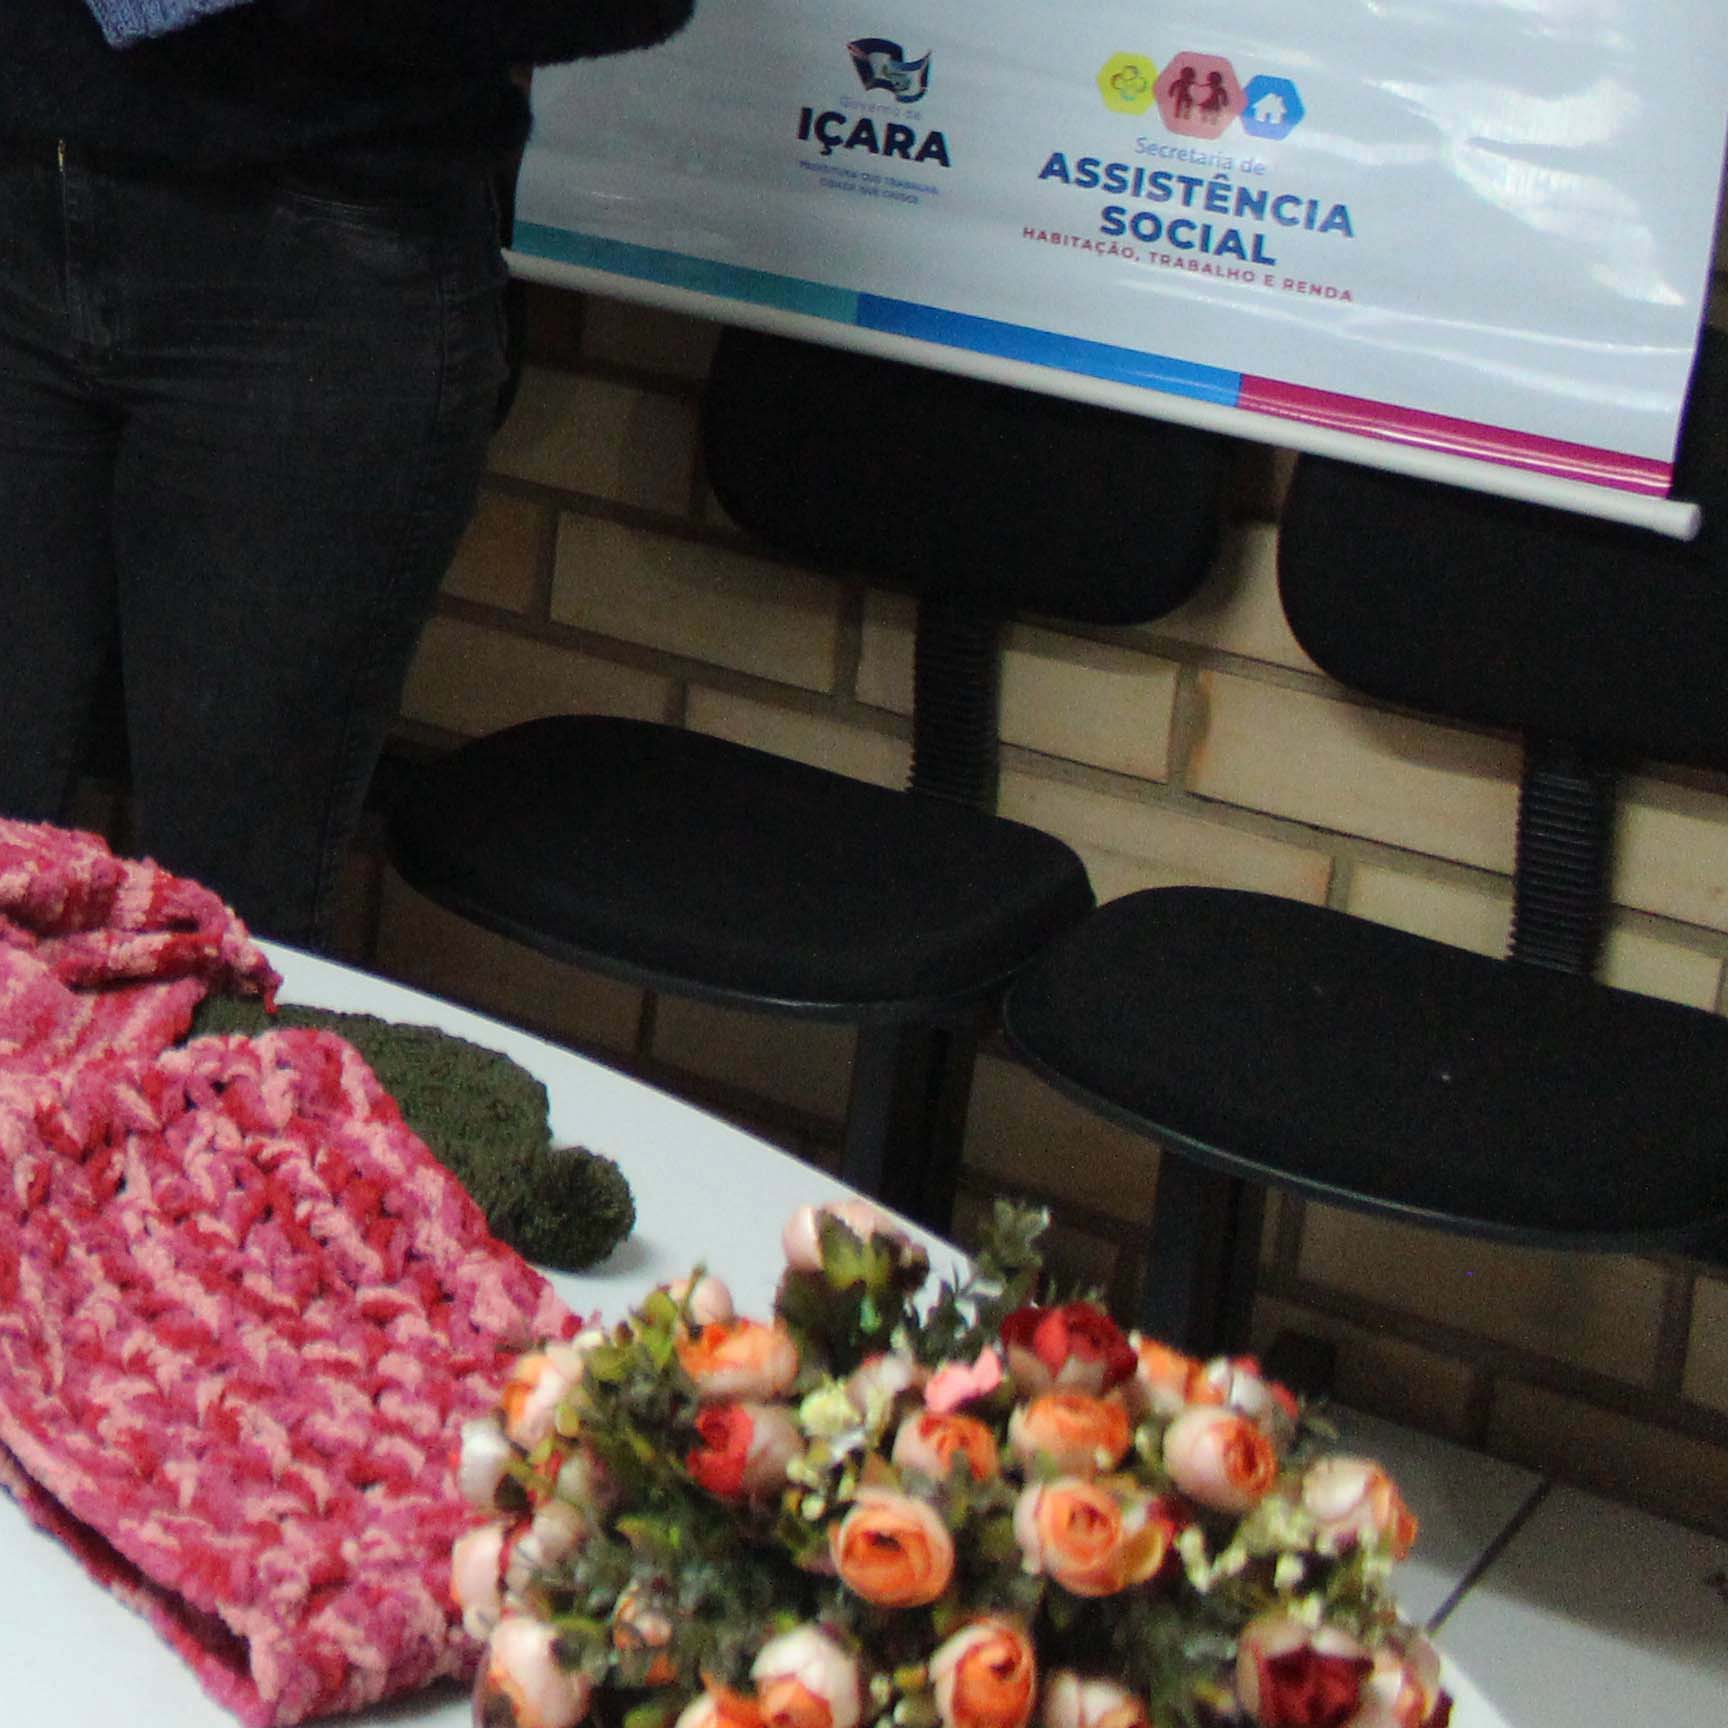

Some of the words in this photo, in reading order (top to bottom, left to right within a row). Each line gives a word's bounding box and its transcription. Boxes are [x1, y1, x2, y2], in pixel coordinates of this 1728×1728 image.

[798, 107, 951, 168] IÇARA
[1135, 137, 1233, 171] Secretaria
[1240, 156, 1266, 176] de
[1039, 151, 1355, 239] ASSISTÊNCIA
[1023, 226, 1141, 263] HABITAÇÃO,
[1150, 250, 1256, 284] TRABALHO
[1263, 275, 1274, 288] E
[1282, 277, 1354, 303] RENDA
[1100, 204, 1277, 267] SOCIAL
